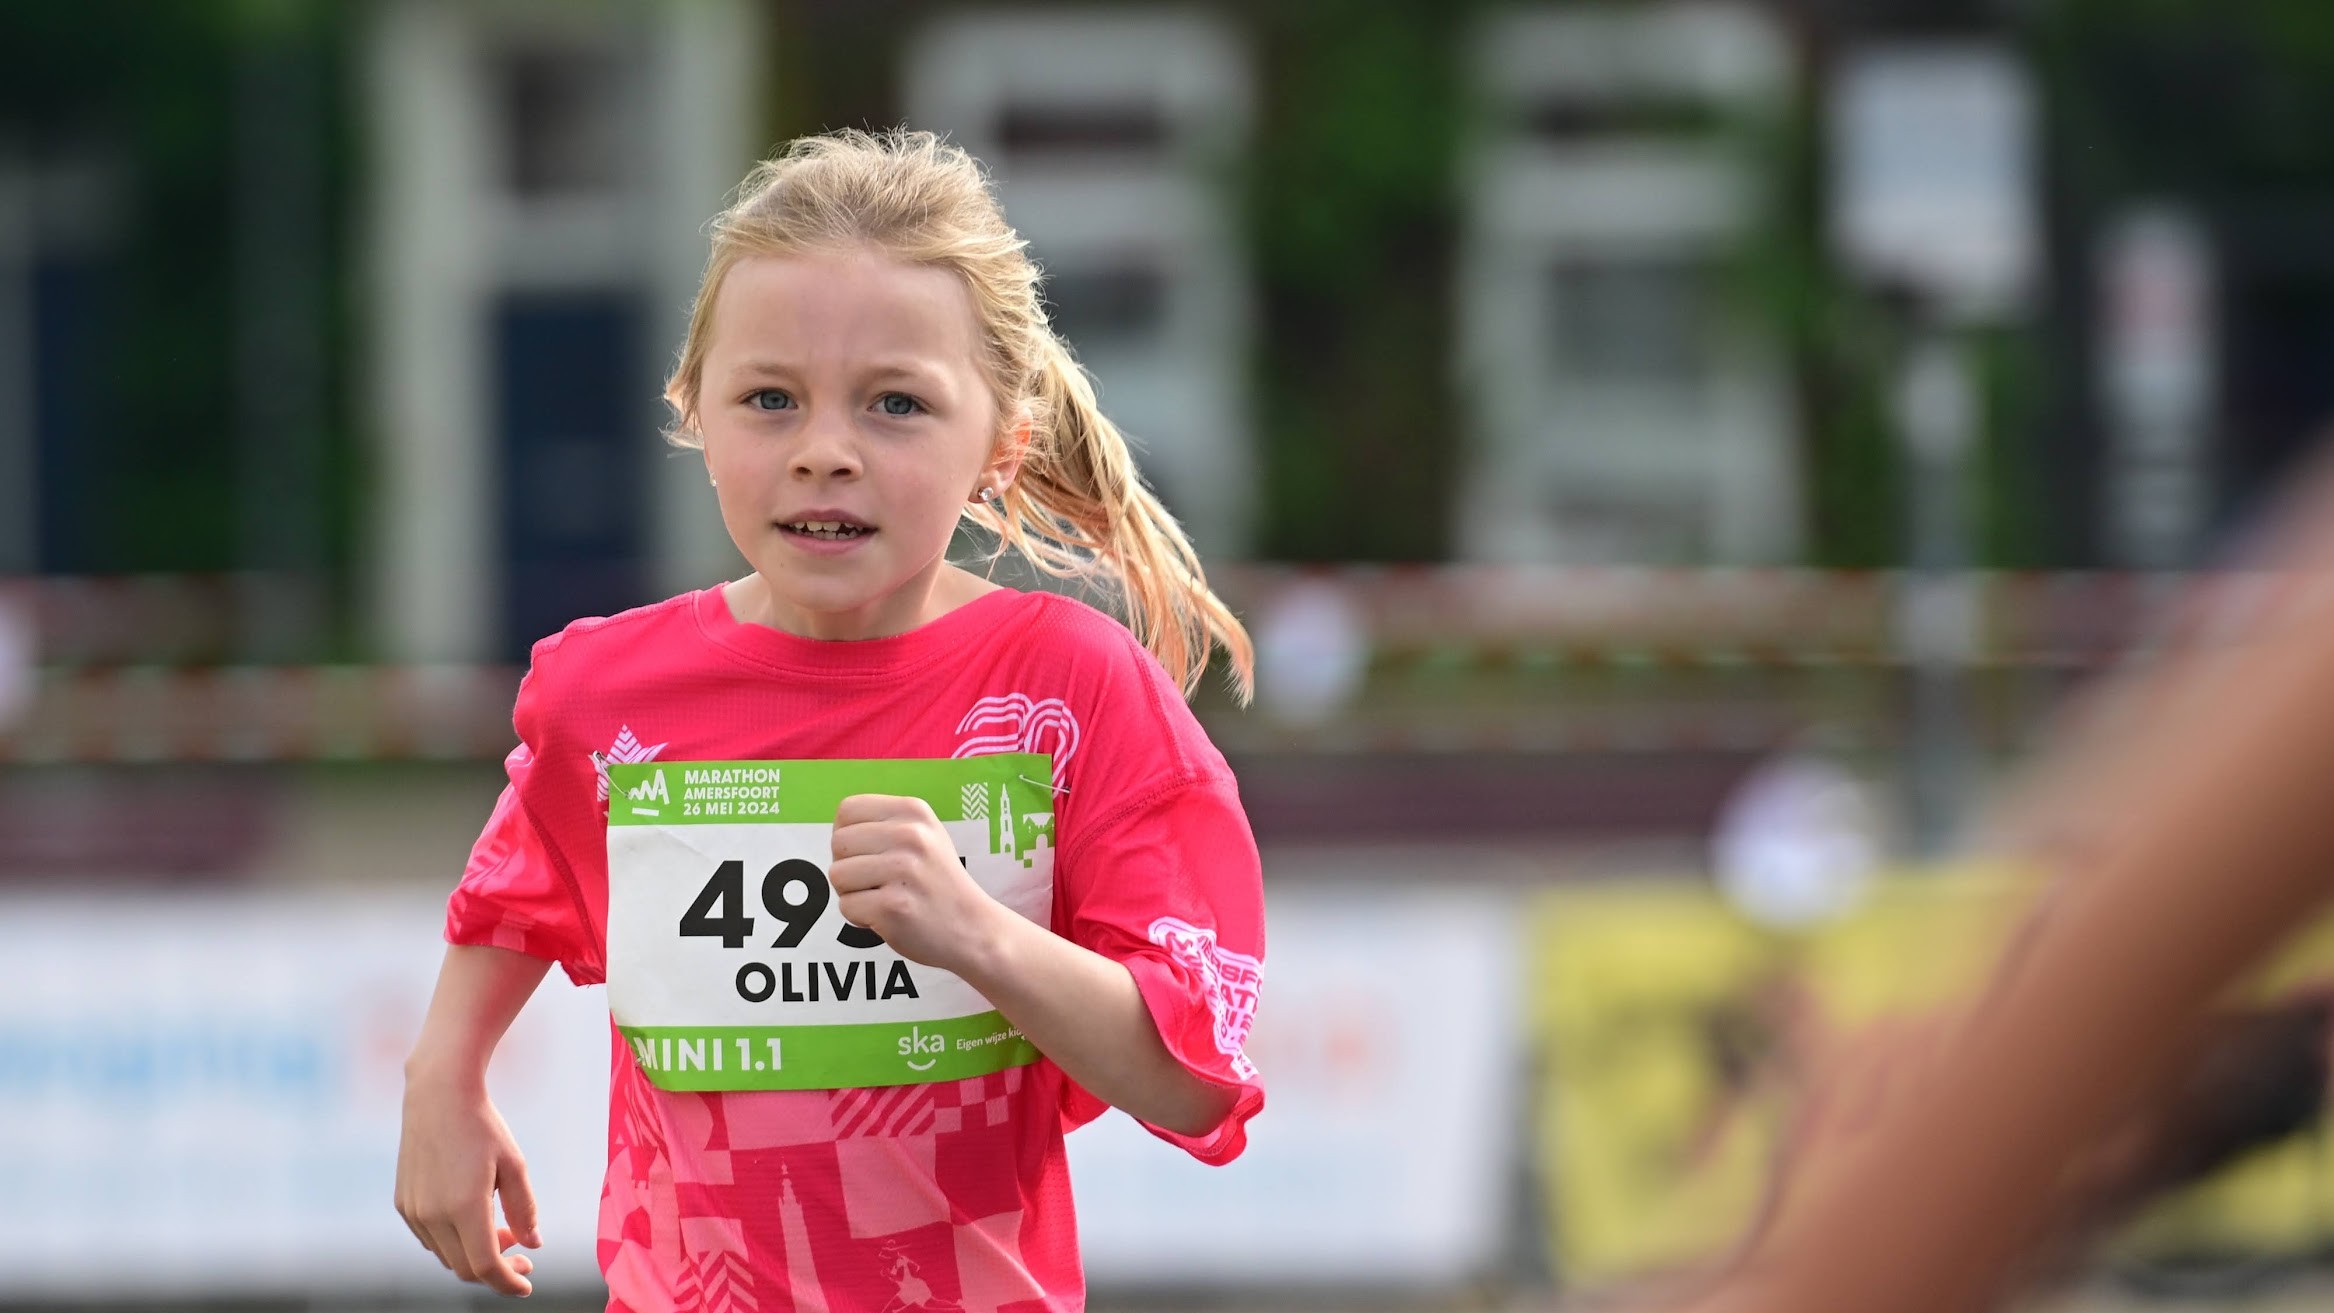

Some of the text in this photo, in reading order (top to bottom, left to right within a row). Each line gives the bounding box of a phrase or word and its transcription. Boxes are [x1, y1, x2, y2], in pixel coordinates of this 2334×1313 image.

[684, 769, 781, 784] MARATHON
[683, 786, 780, 800] AMERSFOORT
[683, 801, 780, 816] 26 MEI 2024
[679, 856, 967, 949] 49
[735, 959, 920, 1003] OLIVIA
[898, 1025, 945, 1056] ska
[956, 1038, 984, 1051] Eigen
[985, 1031, 1007, 1045] wijze
[633, 1037, 783, 1072] MINI 1.1
